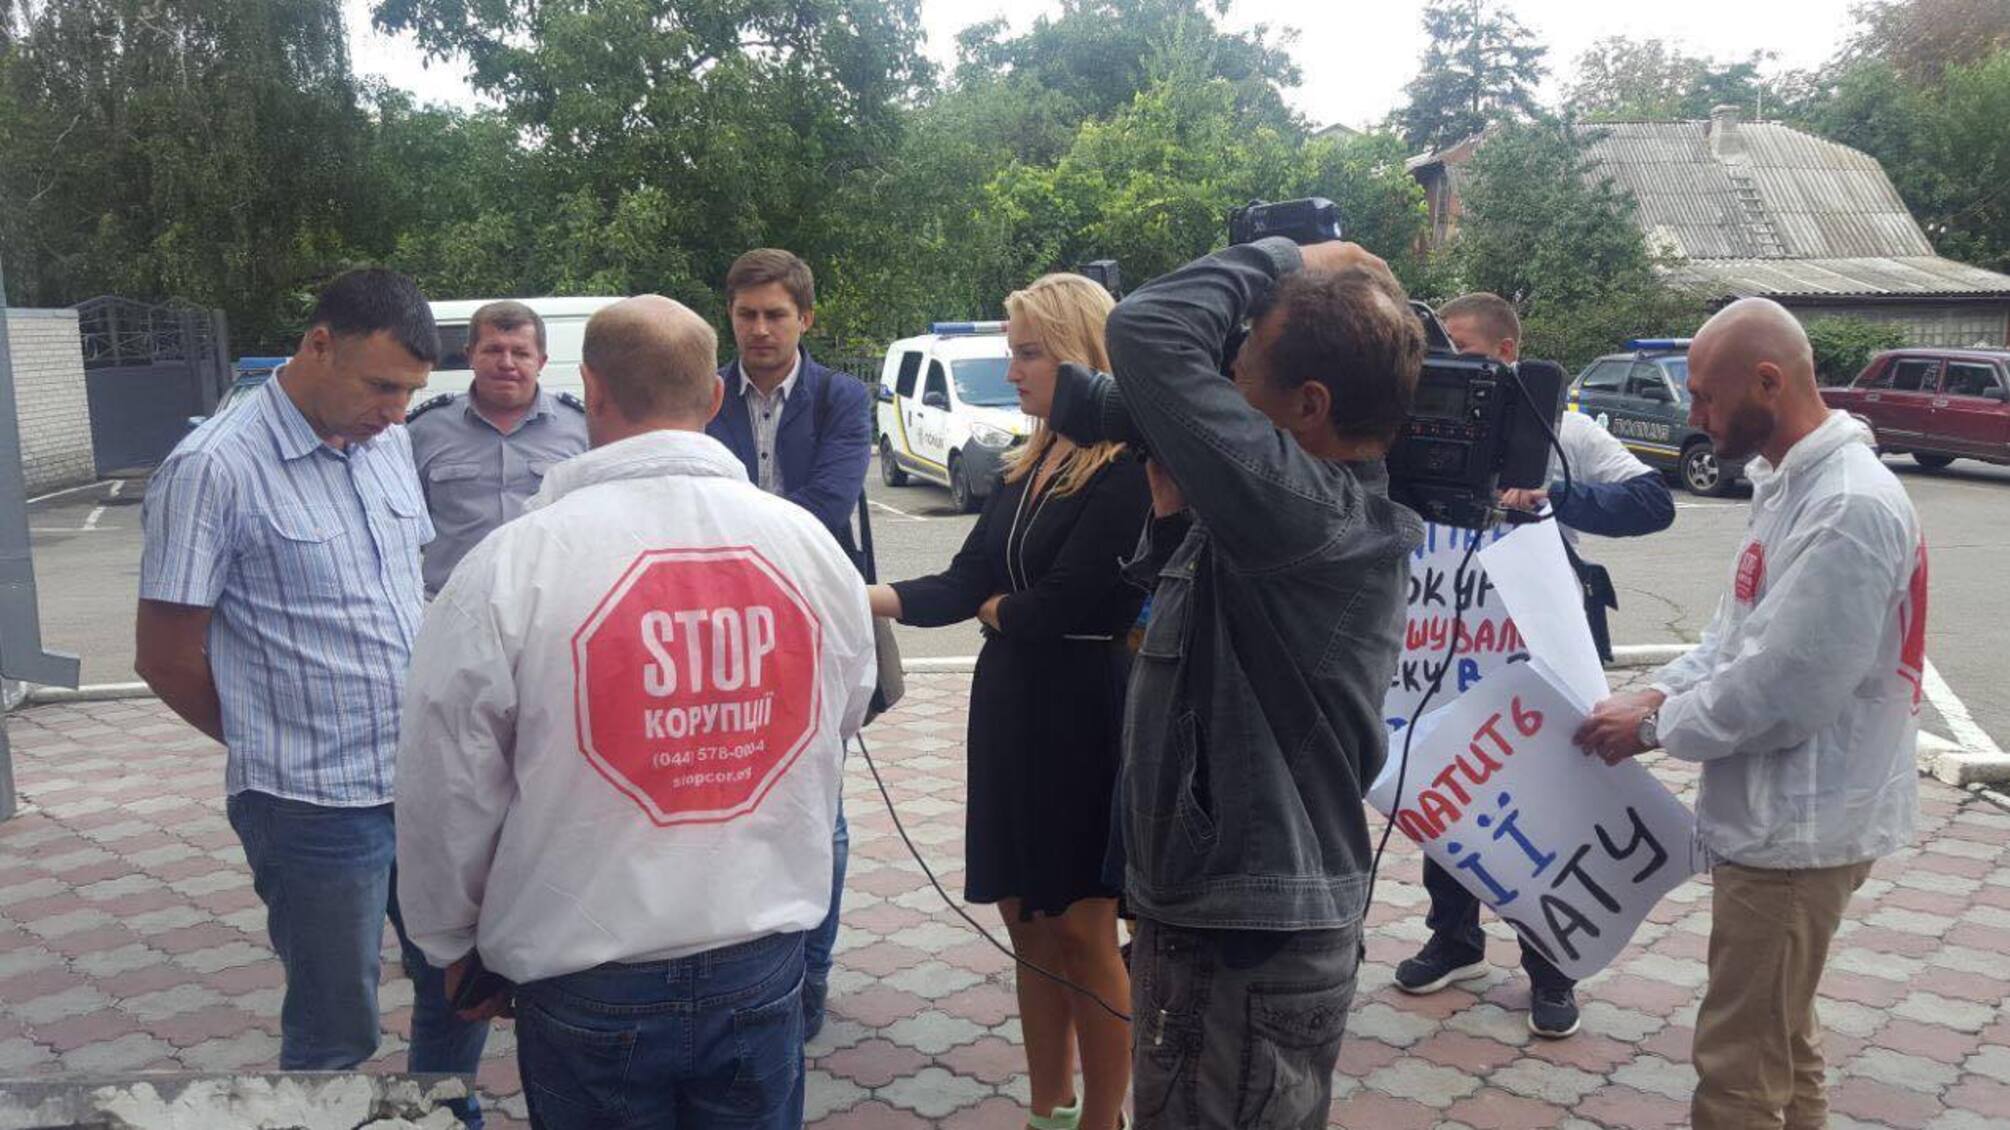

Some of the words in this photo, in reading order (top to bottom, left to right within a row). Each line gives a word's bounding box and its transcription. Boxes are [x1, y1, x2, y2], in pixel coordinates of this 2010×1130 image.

[641, 605, 776, 697] STOP
[1406, 616, 1528, 654] ШУВАЛ
[644, 691, 774, 739] КОРУПЦІЇ
[653, 750, 695, 768] (044)
